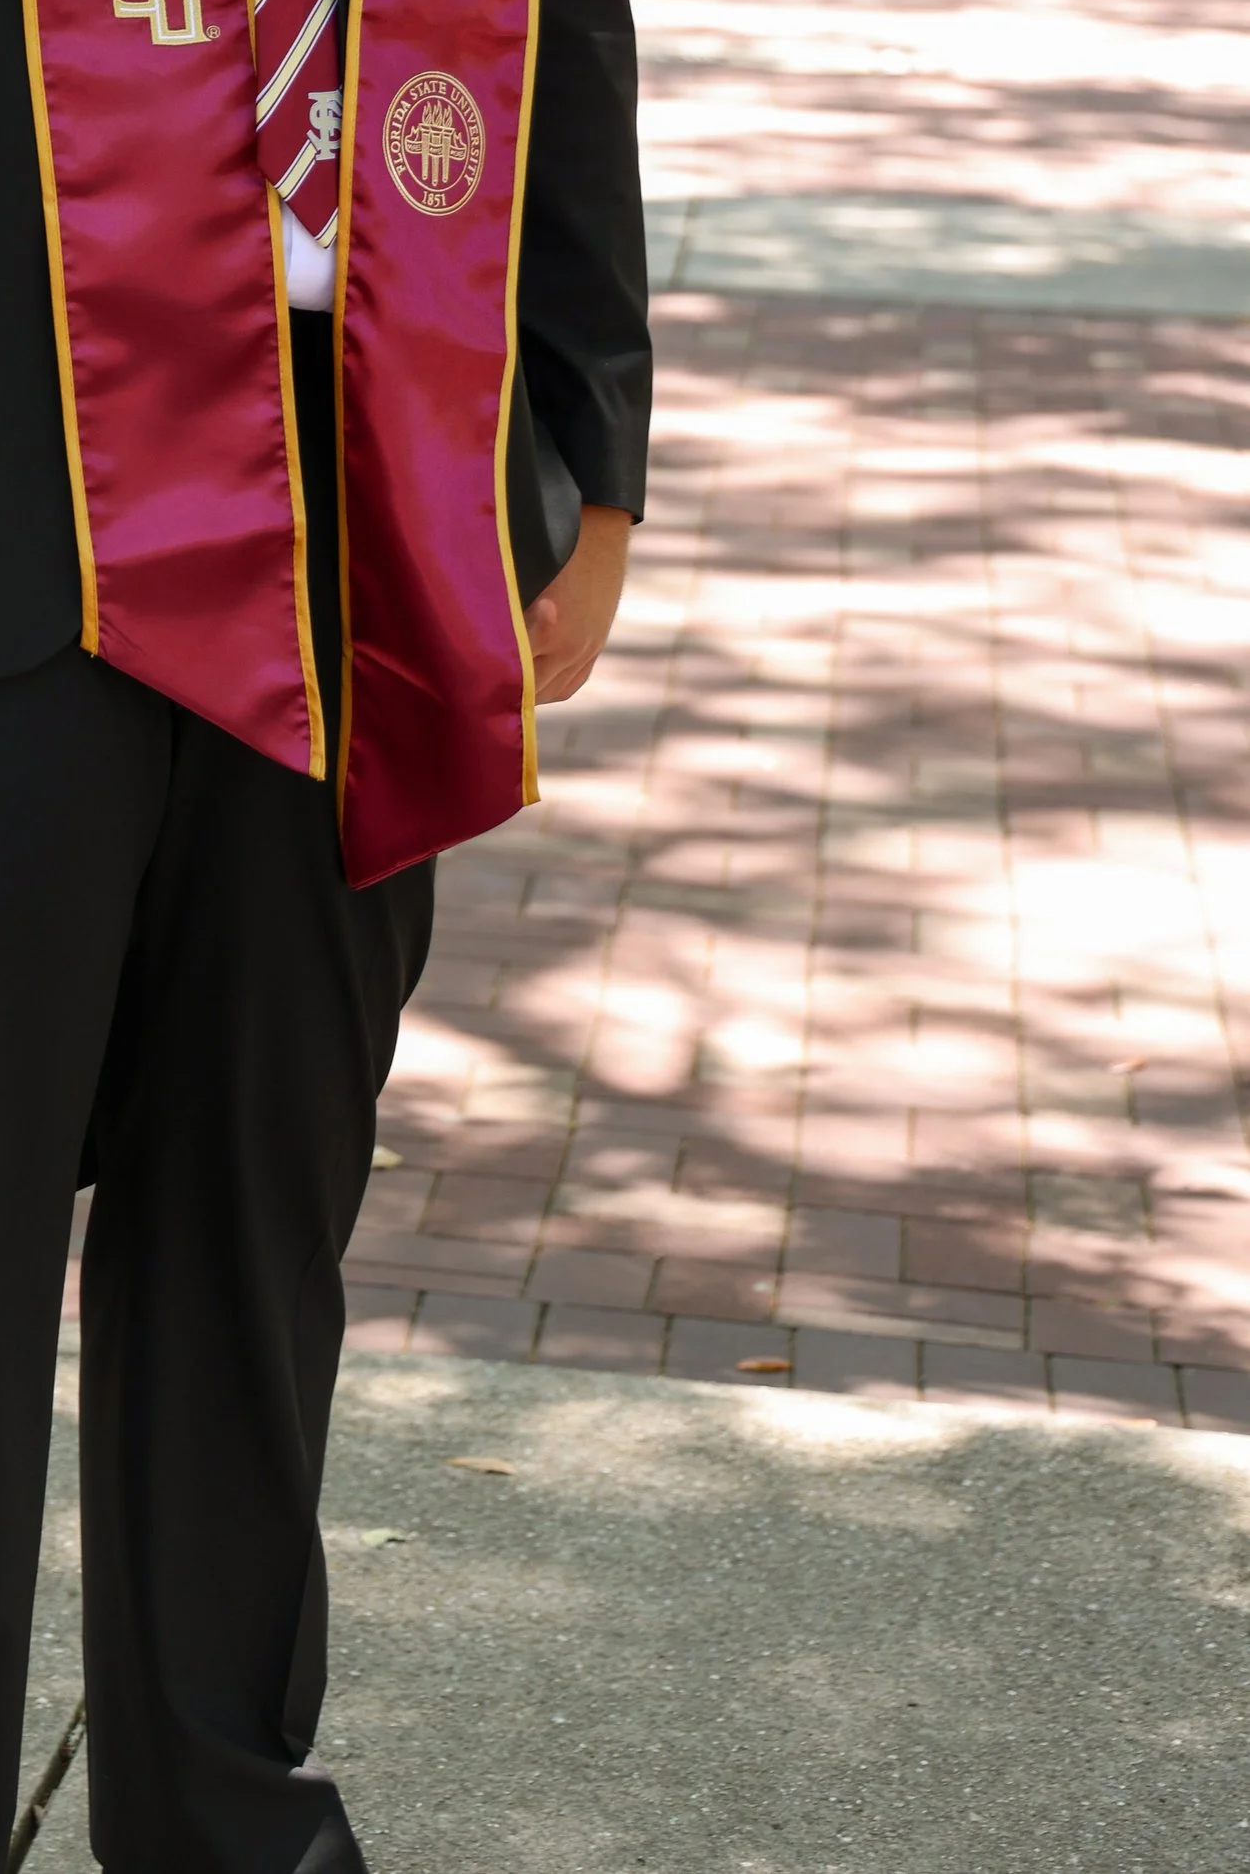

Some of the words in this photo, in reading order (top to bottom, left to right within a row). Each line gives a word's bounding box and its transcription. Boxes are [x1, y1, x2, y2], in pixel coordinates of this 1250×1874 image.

[391, 100, 411, 176] FLORIDA
[410, 80, 447, 101] STATE
[450, 87, 480, 187] UNIVERSITY
[421, 190, 447, 207] 1851
